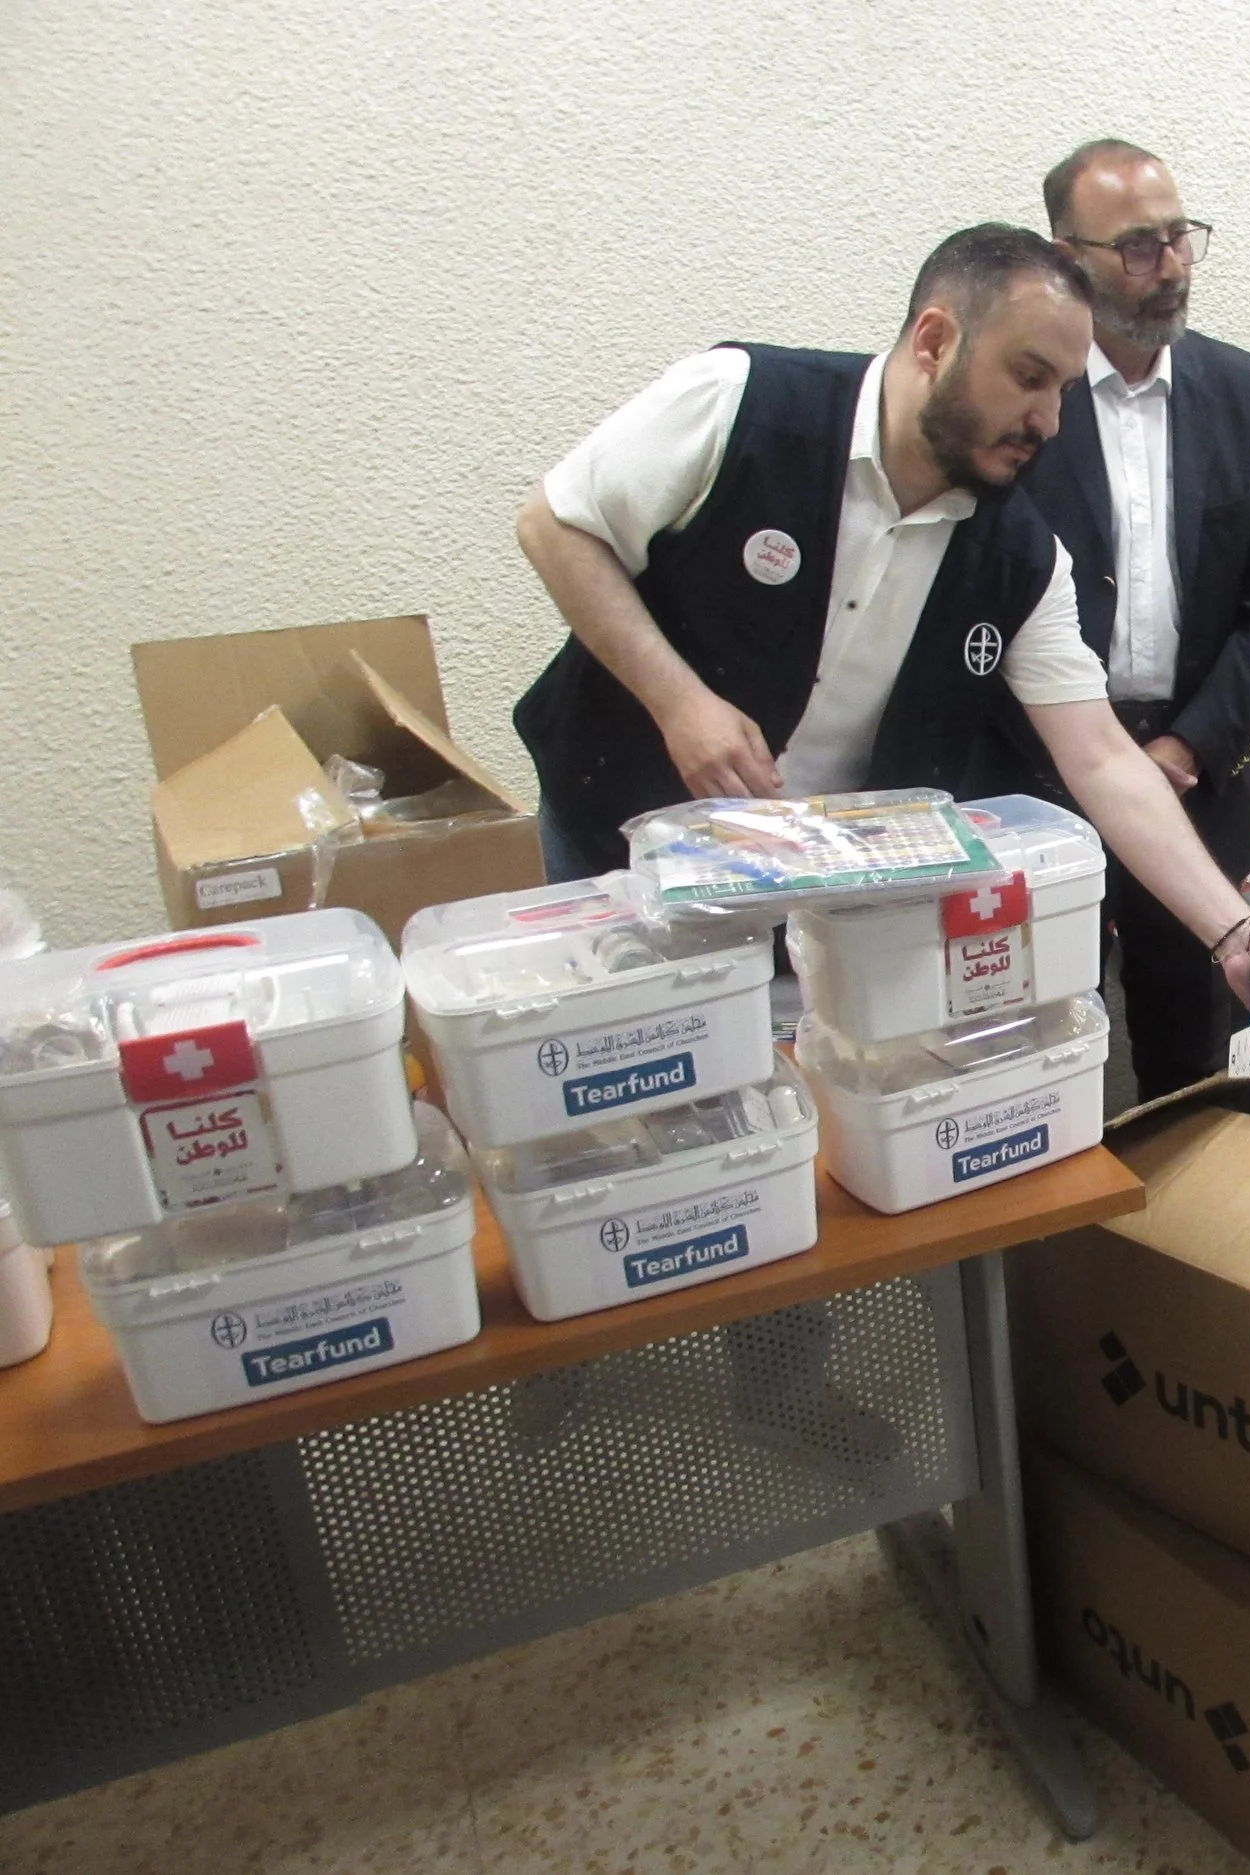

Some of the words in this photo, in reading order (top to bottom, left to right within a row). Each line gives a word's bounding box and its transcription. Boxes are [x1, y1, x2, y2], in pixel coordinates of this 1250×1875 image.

[961, 936, 1010, 961] كلنا
[963, 954, 1011, 982] للوطن
[570, 1061, 686, 1107] Tearfund
[166, 1107, 243, 1140] كلنا
[177, 1129, 249, 1165] للوطن
[958, 1132, 1042, 1174] Tearfund
[631, 1233, 739, 1279] Tearfund
[251, 1326, 381, 1378] Tearfund
[1081, 1607, 1196, 1721] unto
